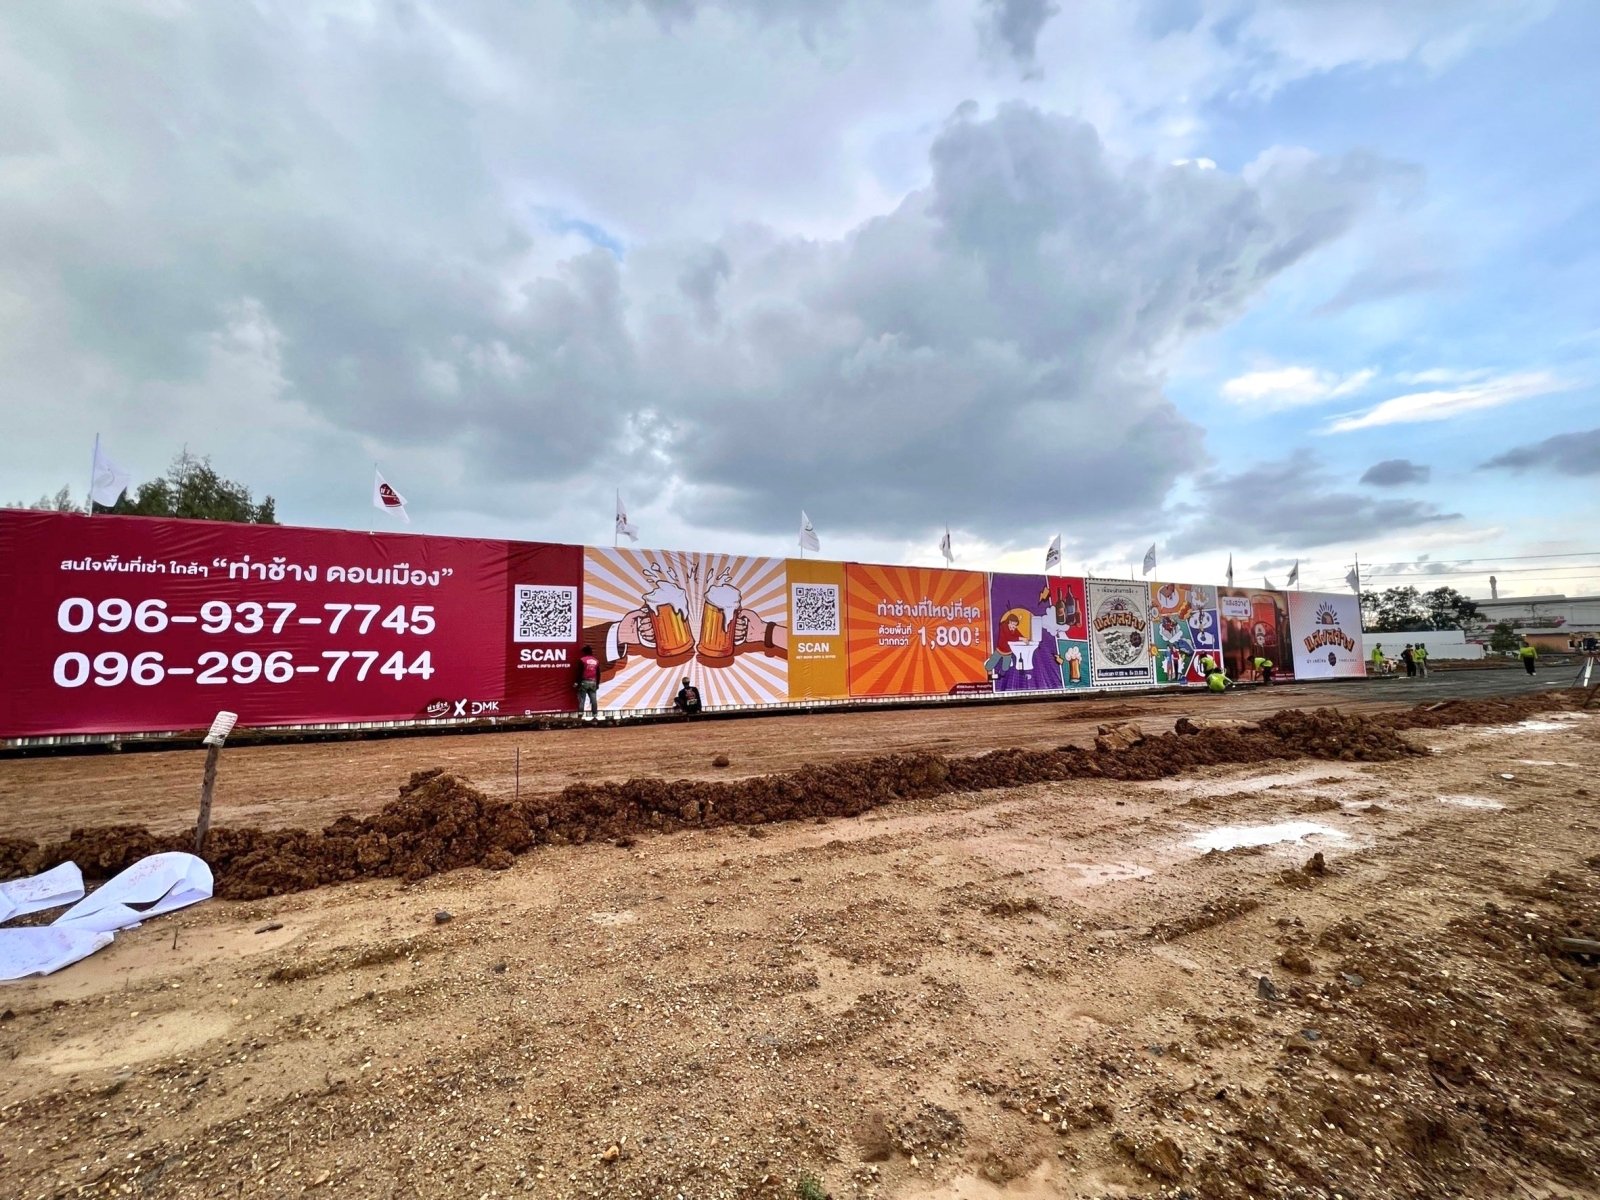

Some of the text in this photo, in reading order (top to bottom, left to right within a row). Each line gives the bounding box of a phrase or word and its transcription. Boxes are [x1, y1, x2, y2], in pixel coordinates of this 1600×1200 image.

[60, 554, 166, 574] สนใจพื้นที่เช่า
[169, 560, 209, 578] ใกล้ๆ
[57, 597, 436, 635] 096-937-7745
[877, 596, 981, 624] ท่าช้างที่ใหญ่ที่สุด
[797, 642, 830, 653] SCAN
[917, 625, 972, 650] 1,800
[519, 648, 567, 662] SCAN
[53, 650, 435, 688] 096-296-7744
[471, 701, 500, 715] DMK
